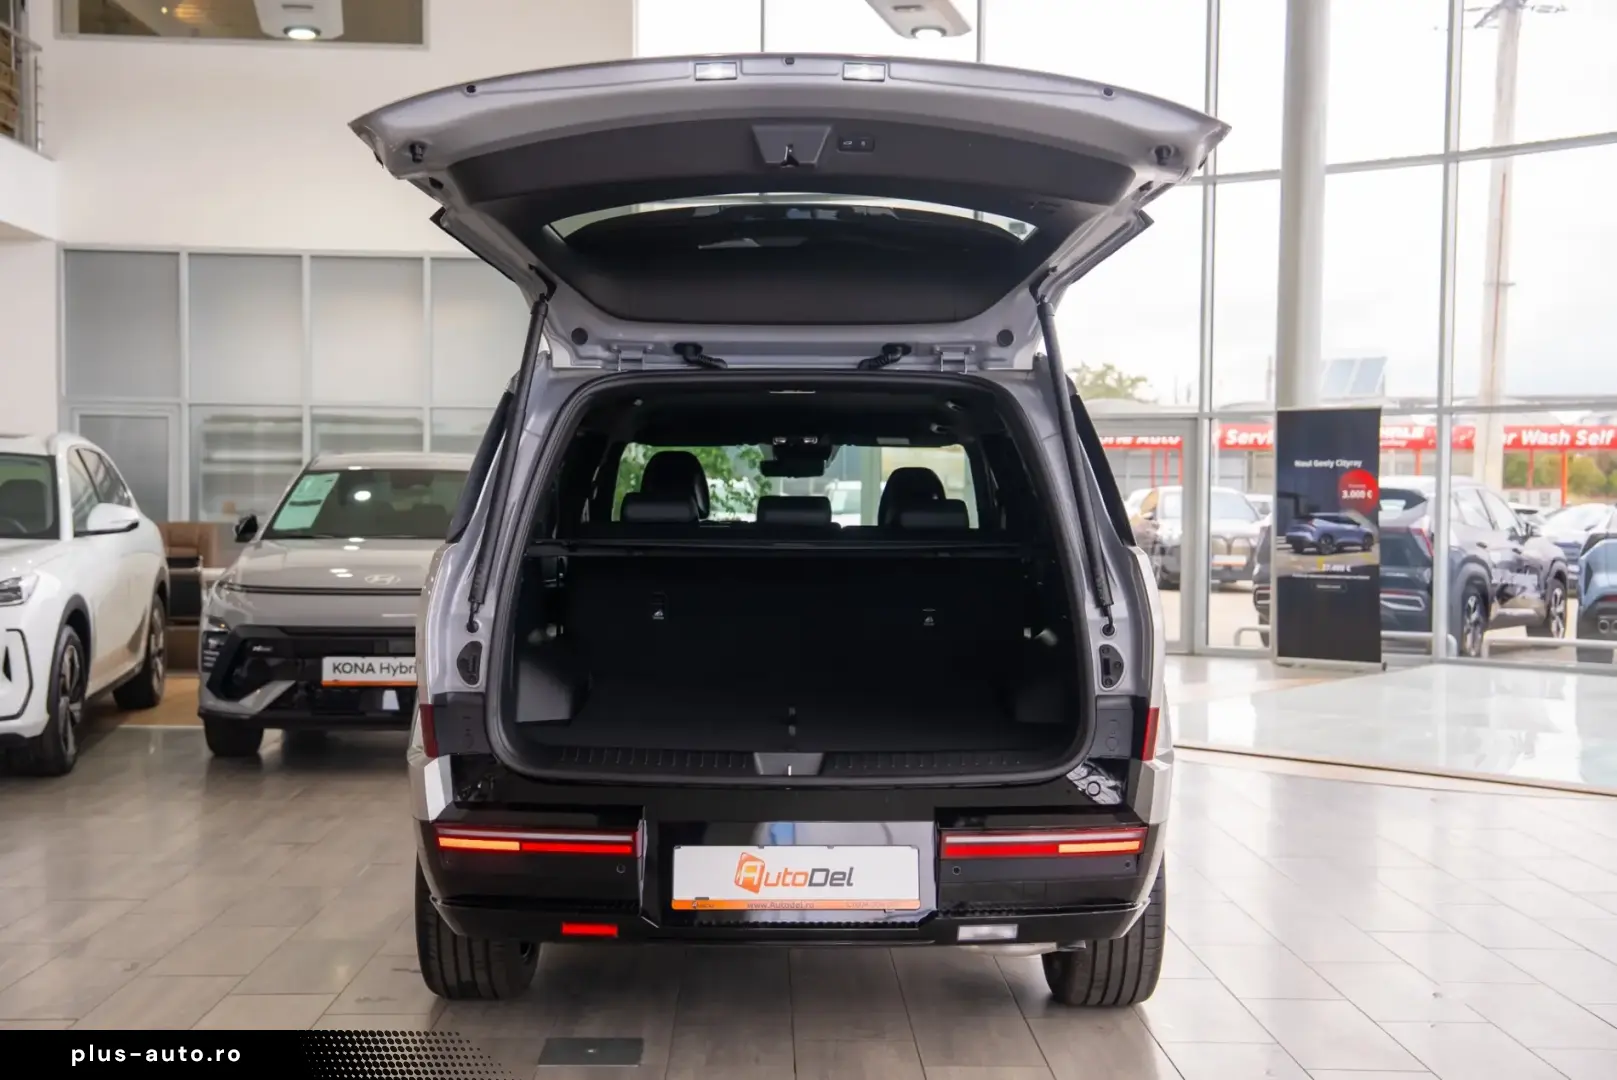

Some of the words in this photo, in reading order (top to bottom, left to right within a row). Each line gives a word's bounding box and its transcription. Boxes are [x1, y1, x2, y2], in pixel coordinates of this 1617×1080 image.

[1521, 428, 1571, 446] Wash
[1575, 428, 1615, 446] Self
[332, 662, 376, 675] KONA
[734, 855, 854, 890] AutoDel
